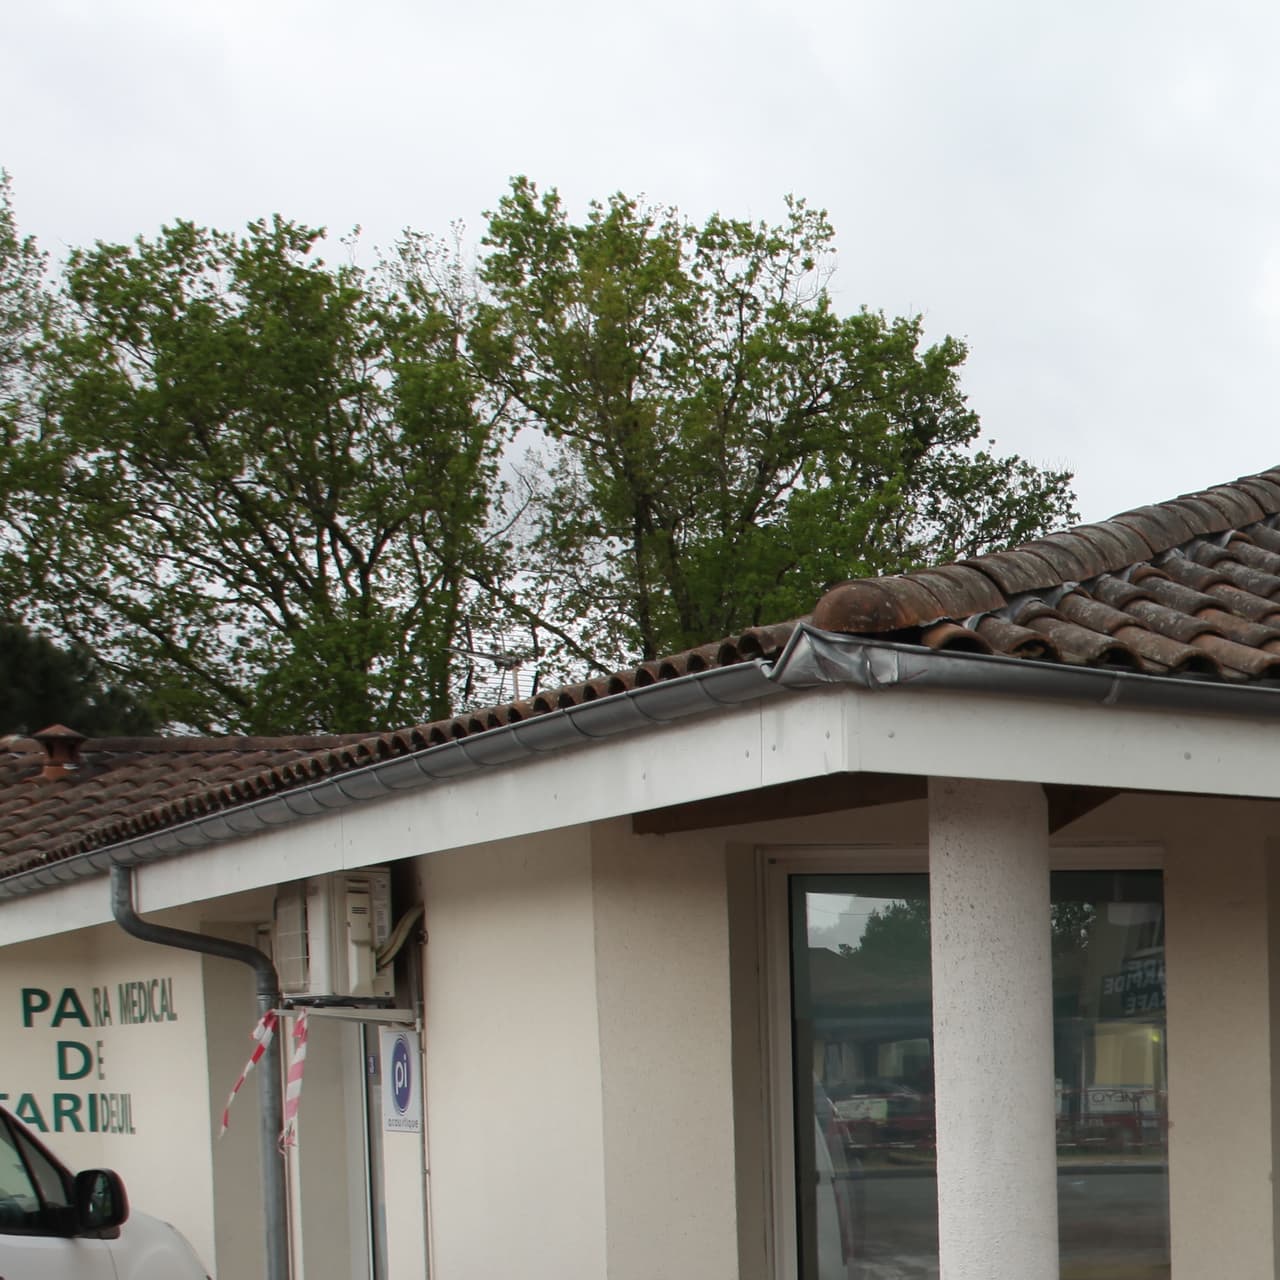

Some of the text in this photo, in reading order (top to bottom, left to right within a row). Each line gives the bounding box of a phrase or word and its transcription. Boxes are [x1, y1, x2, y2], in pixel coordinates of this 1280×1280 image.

[119, 977, 178, 1025] MEDICAL
[57, 1040, 105, 1080] DE
[395, 1053, 407, 1093] pi
[0, 1093, 136, 1134] ARIDEUIL
